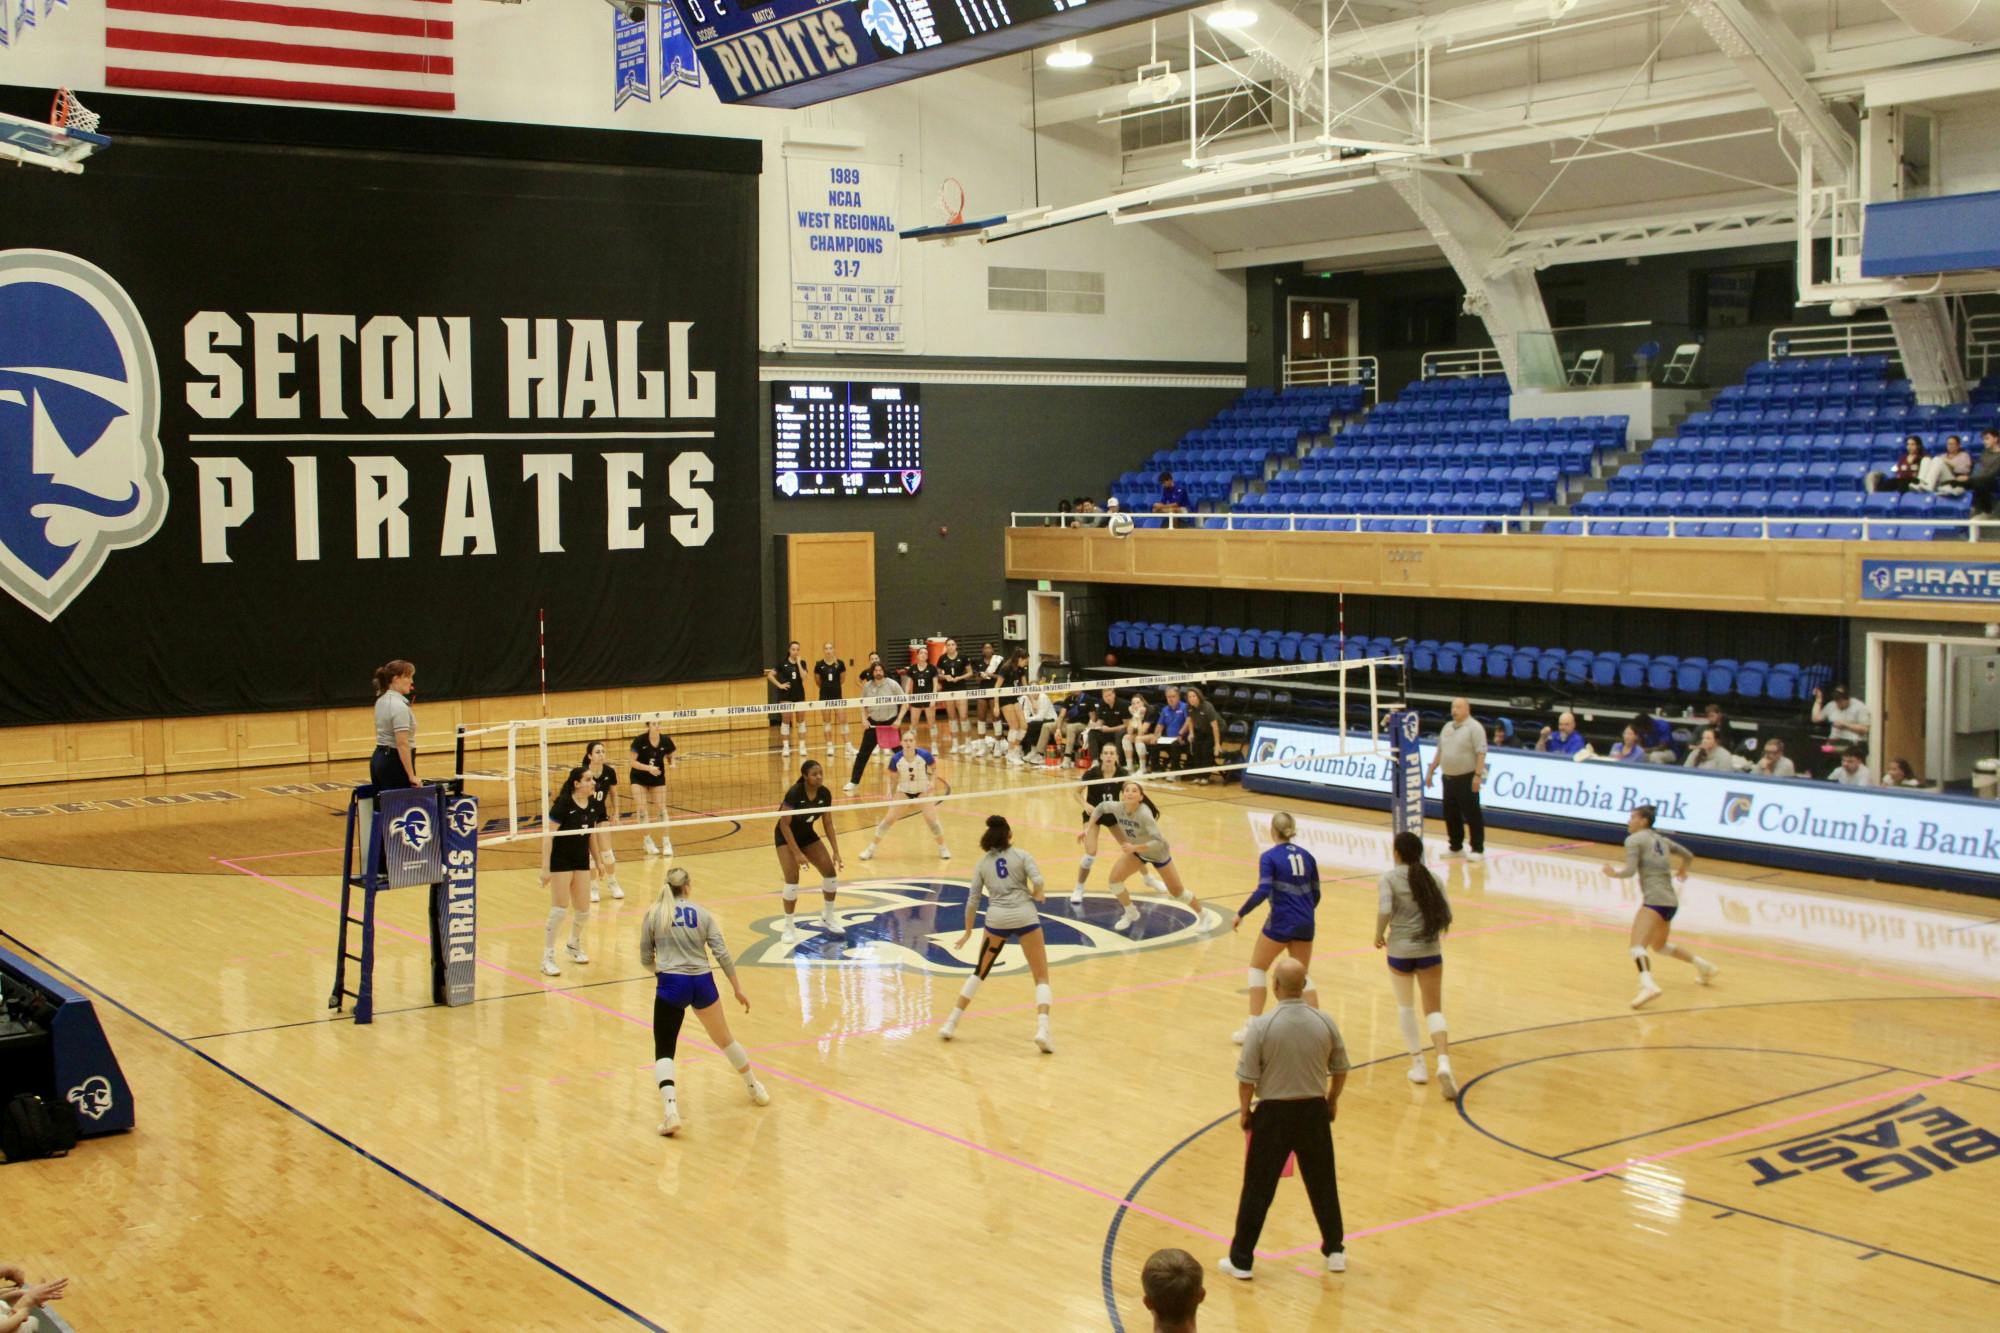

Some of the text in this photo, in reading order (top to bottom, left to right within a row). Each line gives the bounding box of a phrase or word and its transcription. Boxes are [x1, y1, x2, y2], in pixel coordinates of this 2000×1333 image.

[752, 7, 777, 24] MATCH
[696, 26, 719, 42] SCORE
[712, 9, 858, 97] PIRATES
[830, 167, 860, 185] 1989
[828, 190, 862, 208] NCAA
[797, 211, 895, 232] WEST REGIONAL
[809, 235, 883, 254] CHAMPIONS
[834, 259, 860, 278] 31-7
[184, 310, 716, 420] SETON HALL
[190, 450, 715, 564] PIRATES
[917, 678, 926, 687] 12
[567, 717, 586, 726] SETON
[588, 716, 605, 724] HALL
[606, 713, 641, 723] UNIVERSITY
[673, 710, 697, 718] PIRATES
[727, 706, 745, 715] SETON
[746, 705, 761, 713] HALL
[763, 703, 796, 712] UNIVERSITY
[1279, 745, 1376, 780] Columbia
[0, 789, 246, 818] SETON
[593, 790, 604, 802] 10
[1405, 752, 1424, 839] PIRATES
[1493, 770, 1689, 820] Columbia Bank
[1757, 803, 2000, 861] Columbia Bank
[995, 857, 1009, 879] 6
[1287, 853, 1305, 877] 11
[448, 850, 474, 963] PIRATES
[671, 905, 698, 929] 20
[1745, 1105, 1973, 1187] EAST
[1841, 1127, 2000, 1193] BIG
